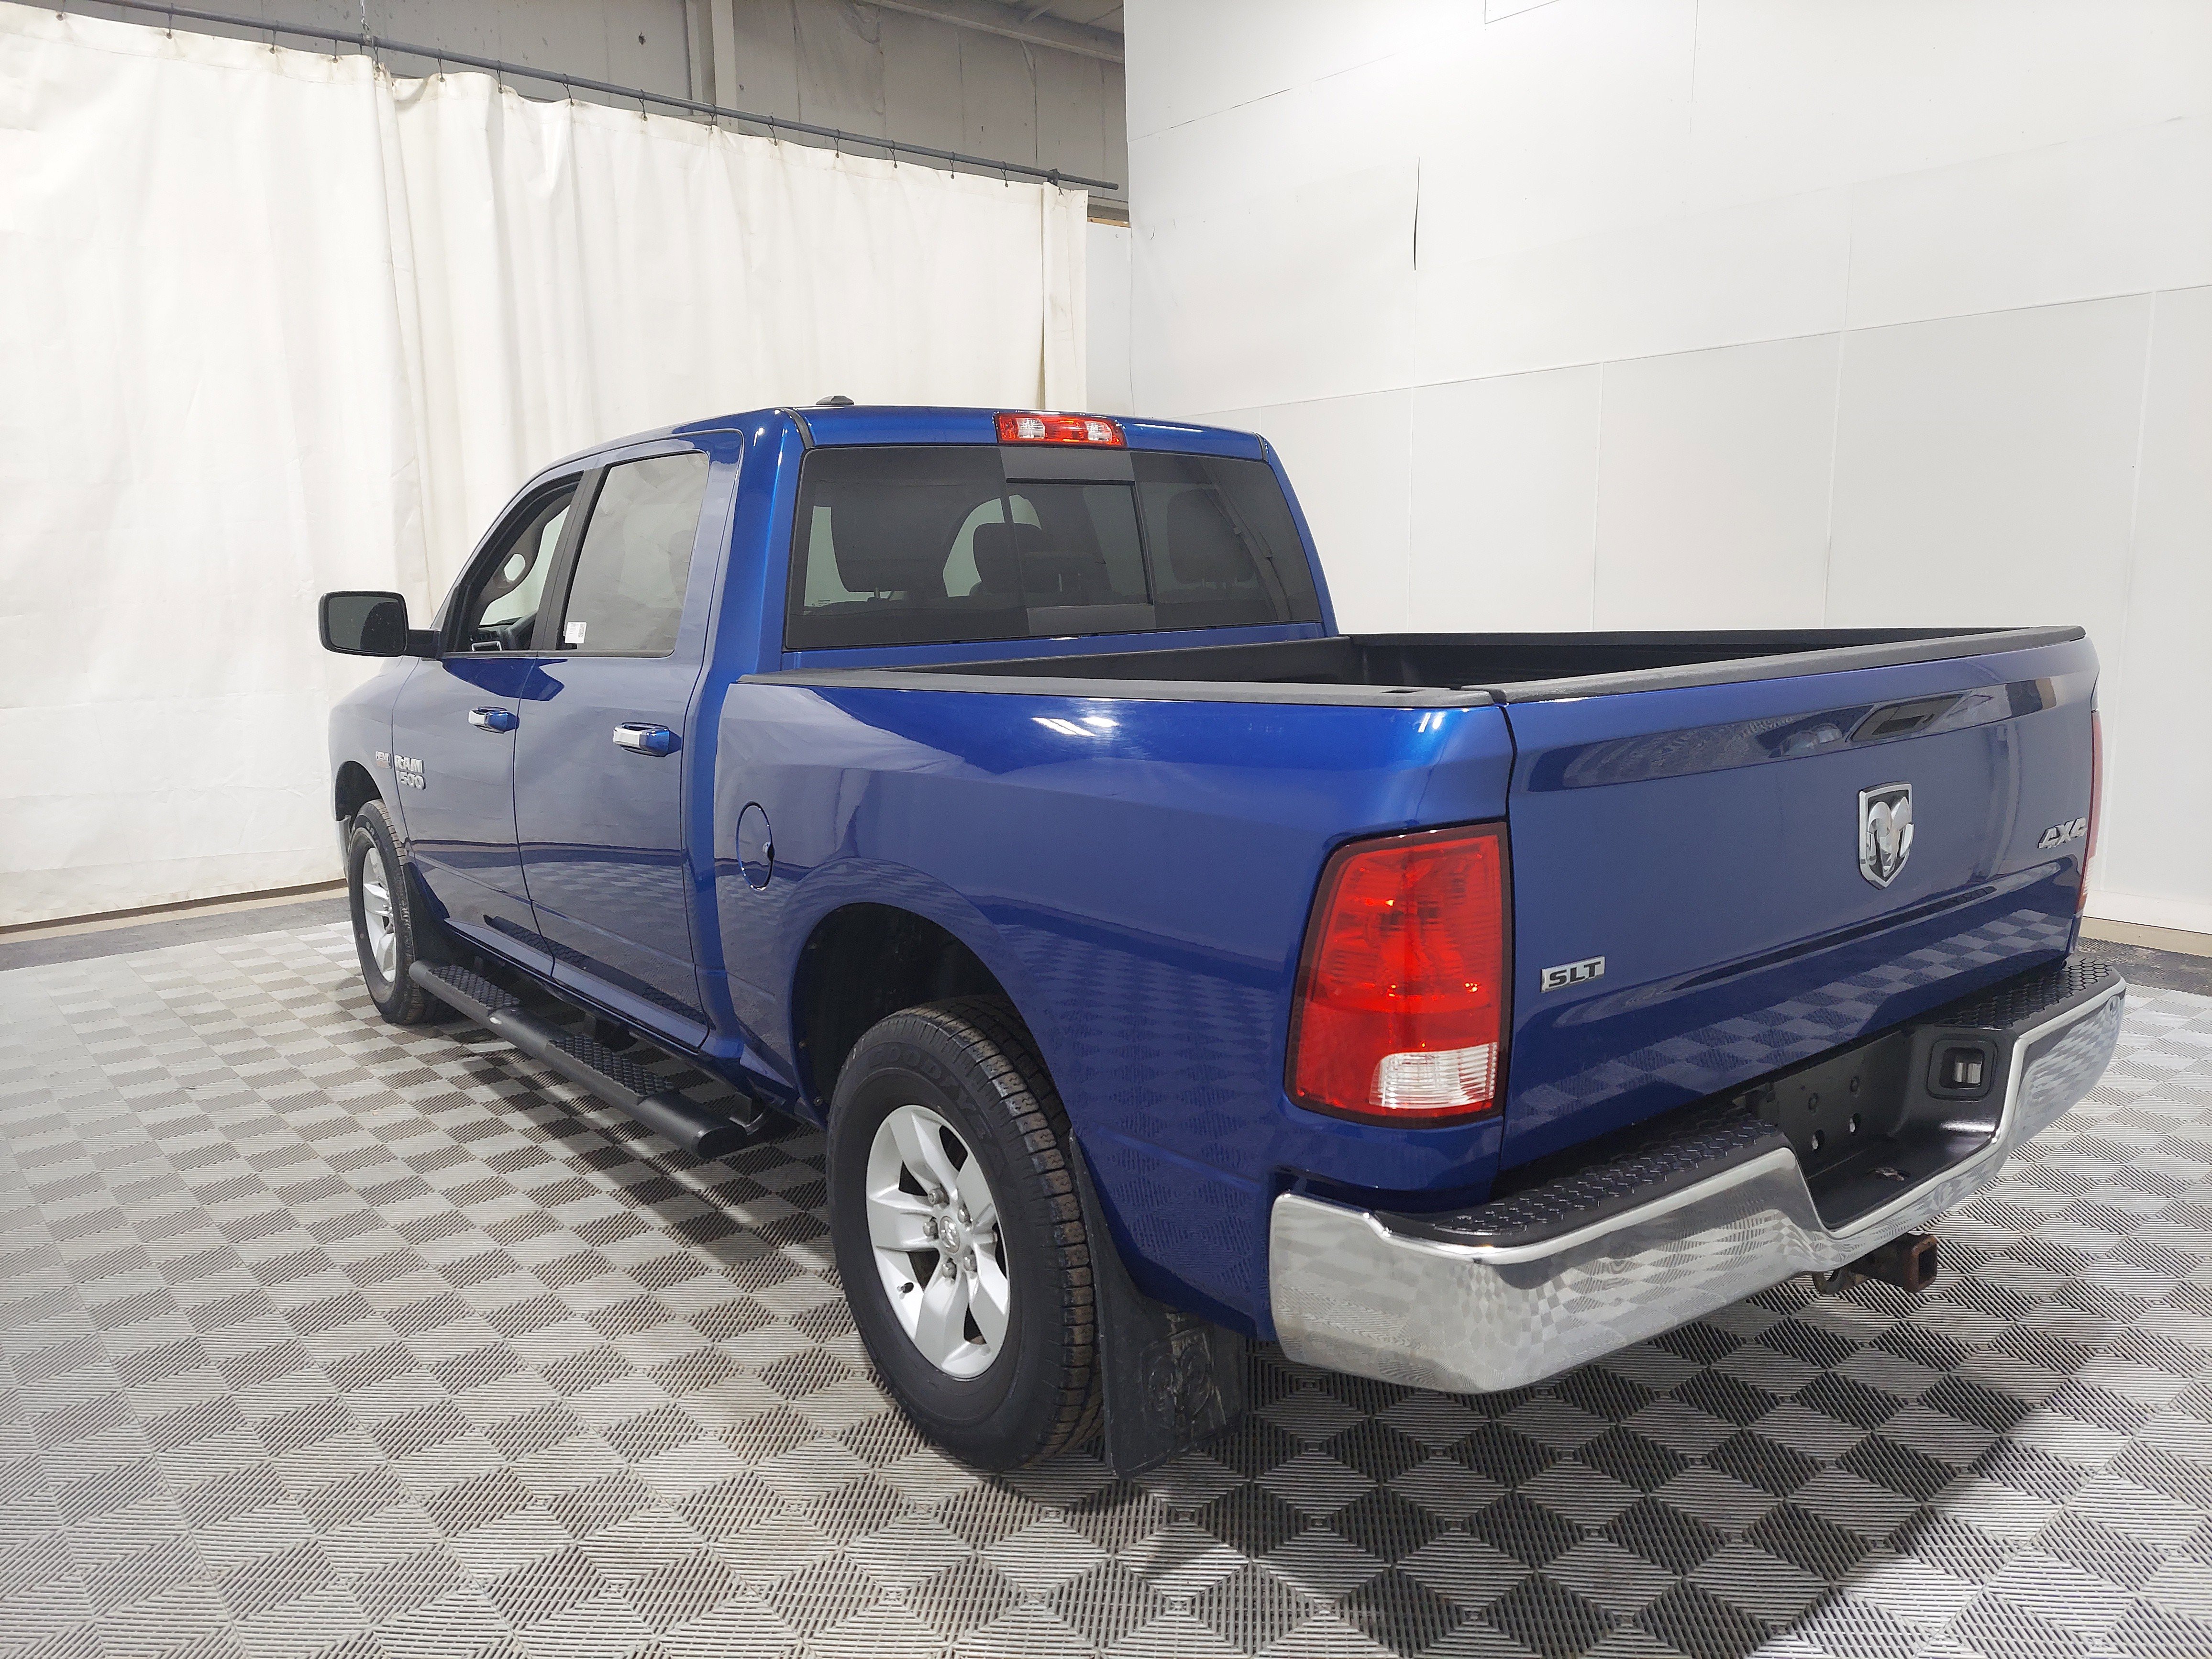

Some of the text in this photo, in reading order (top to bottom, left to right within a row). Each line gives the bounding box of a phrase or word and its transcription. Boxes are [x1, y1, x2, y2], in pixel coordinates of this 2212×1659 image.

[394, 754, 424, 774] RAM
[396, 770, 426, 790] 1500
[1549, 961, 1602, 988] SLT
